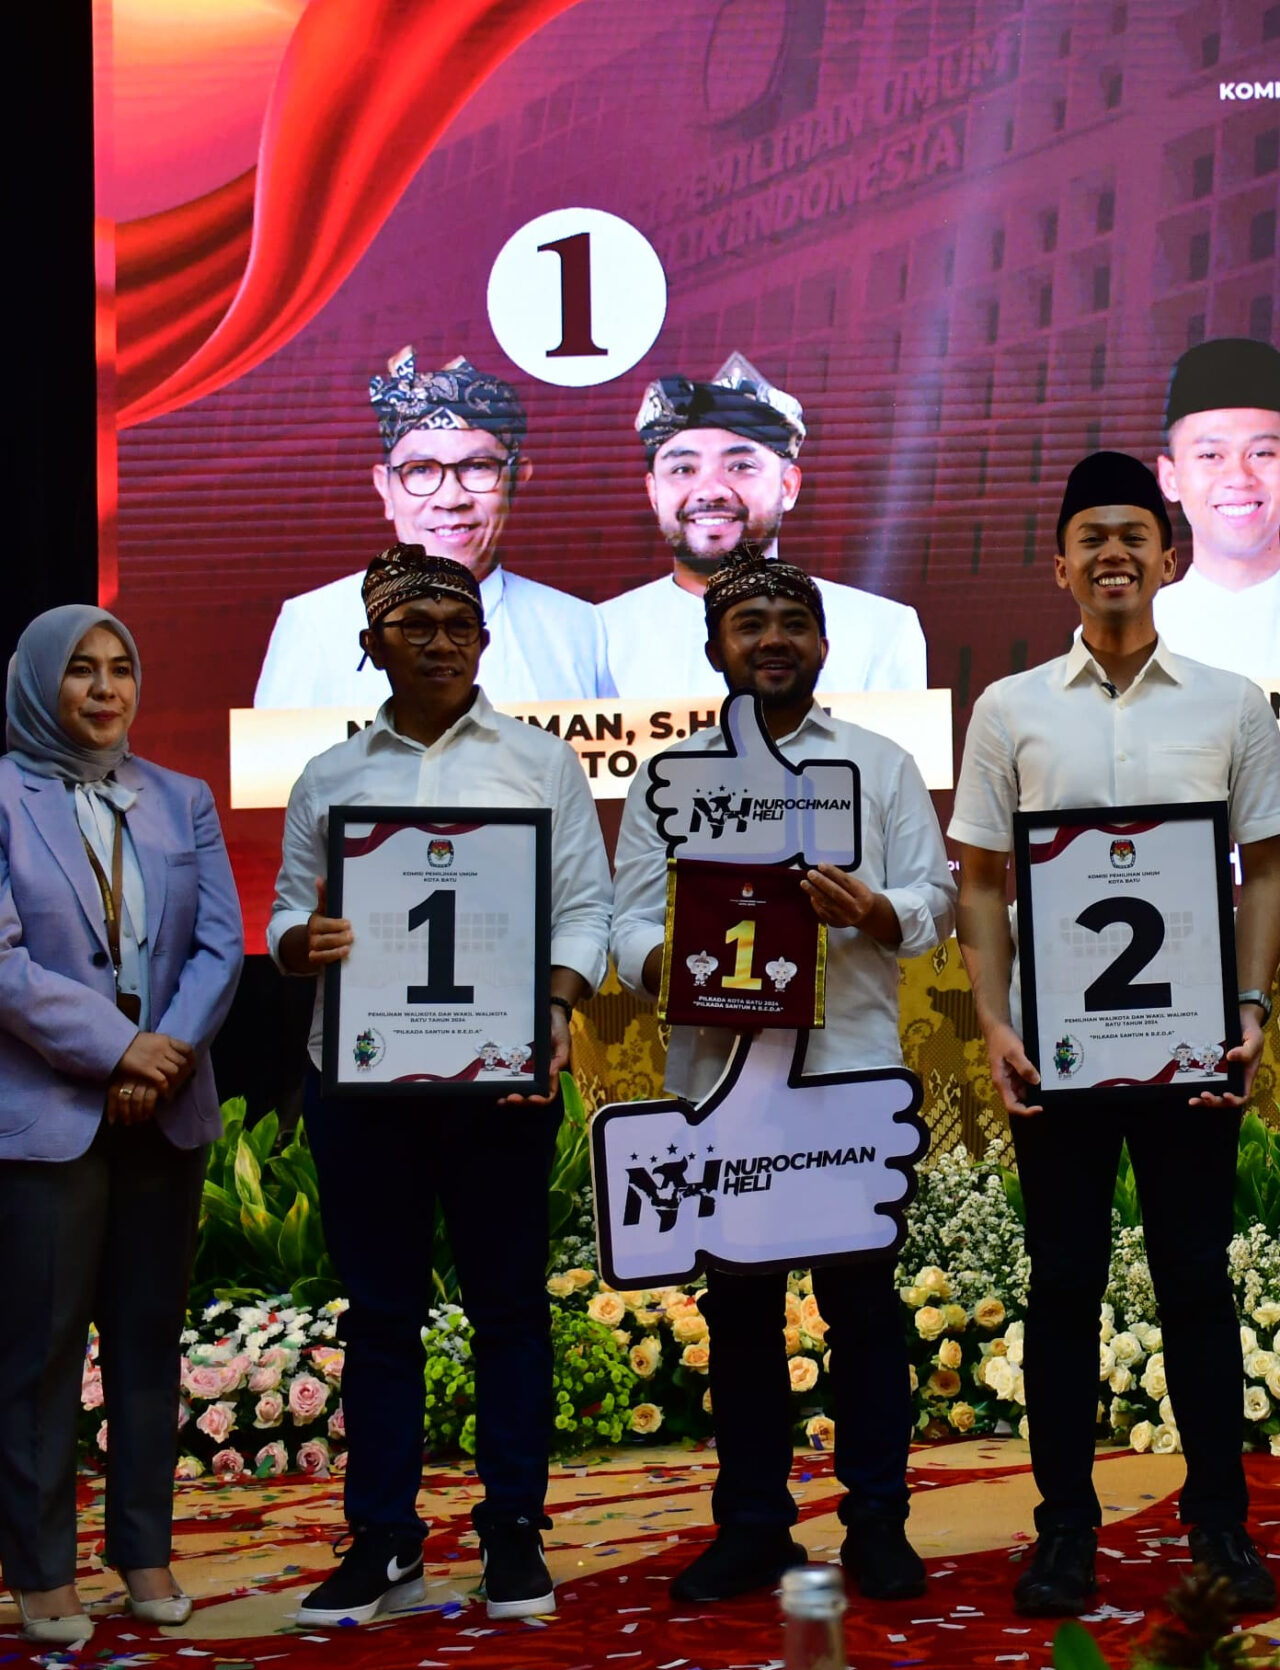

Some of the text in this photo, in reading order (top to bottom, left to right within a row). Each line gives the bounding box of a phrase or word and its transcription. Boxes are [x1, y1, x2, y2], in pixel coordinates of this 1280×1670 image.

[537, 232, 608, 357] 1
[752, 810, 784, 822] HELI
[754, 798, 851, 810] NUROCHMAN
[407, 889, 474, 1004] 1
[721, 920, 763, 991] 1
[1075, 896, 1172, 1012] 2
[698, 995, 726, 1003] PILKADA
[723, 1146, 876, 1178] NUROCHMAN
[722, 1174, 772, 1196] HELI
